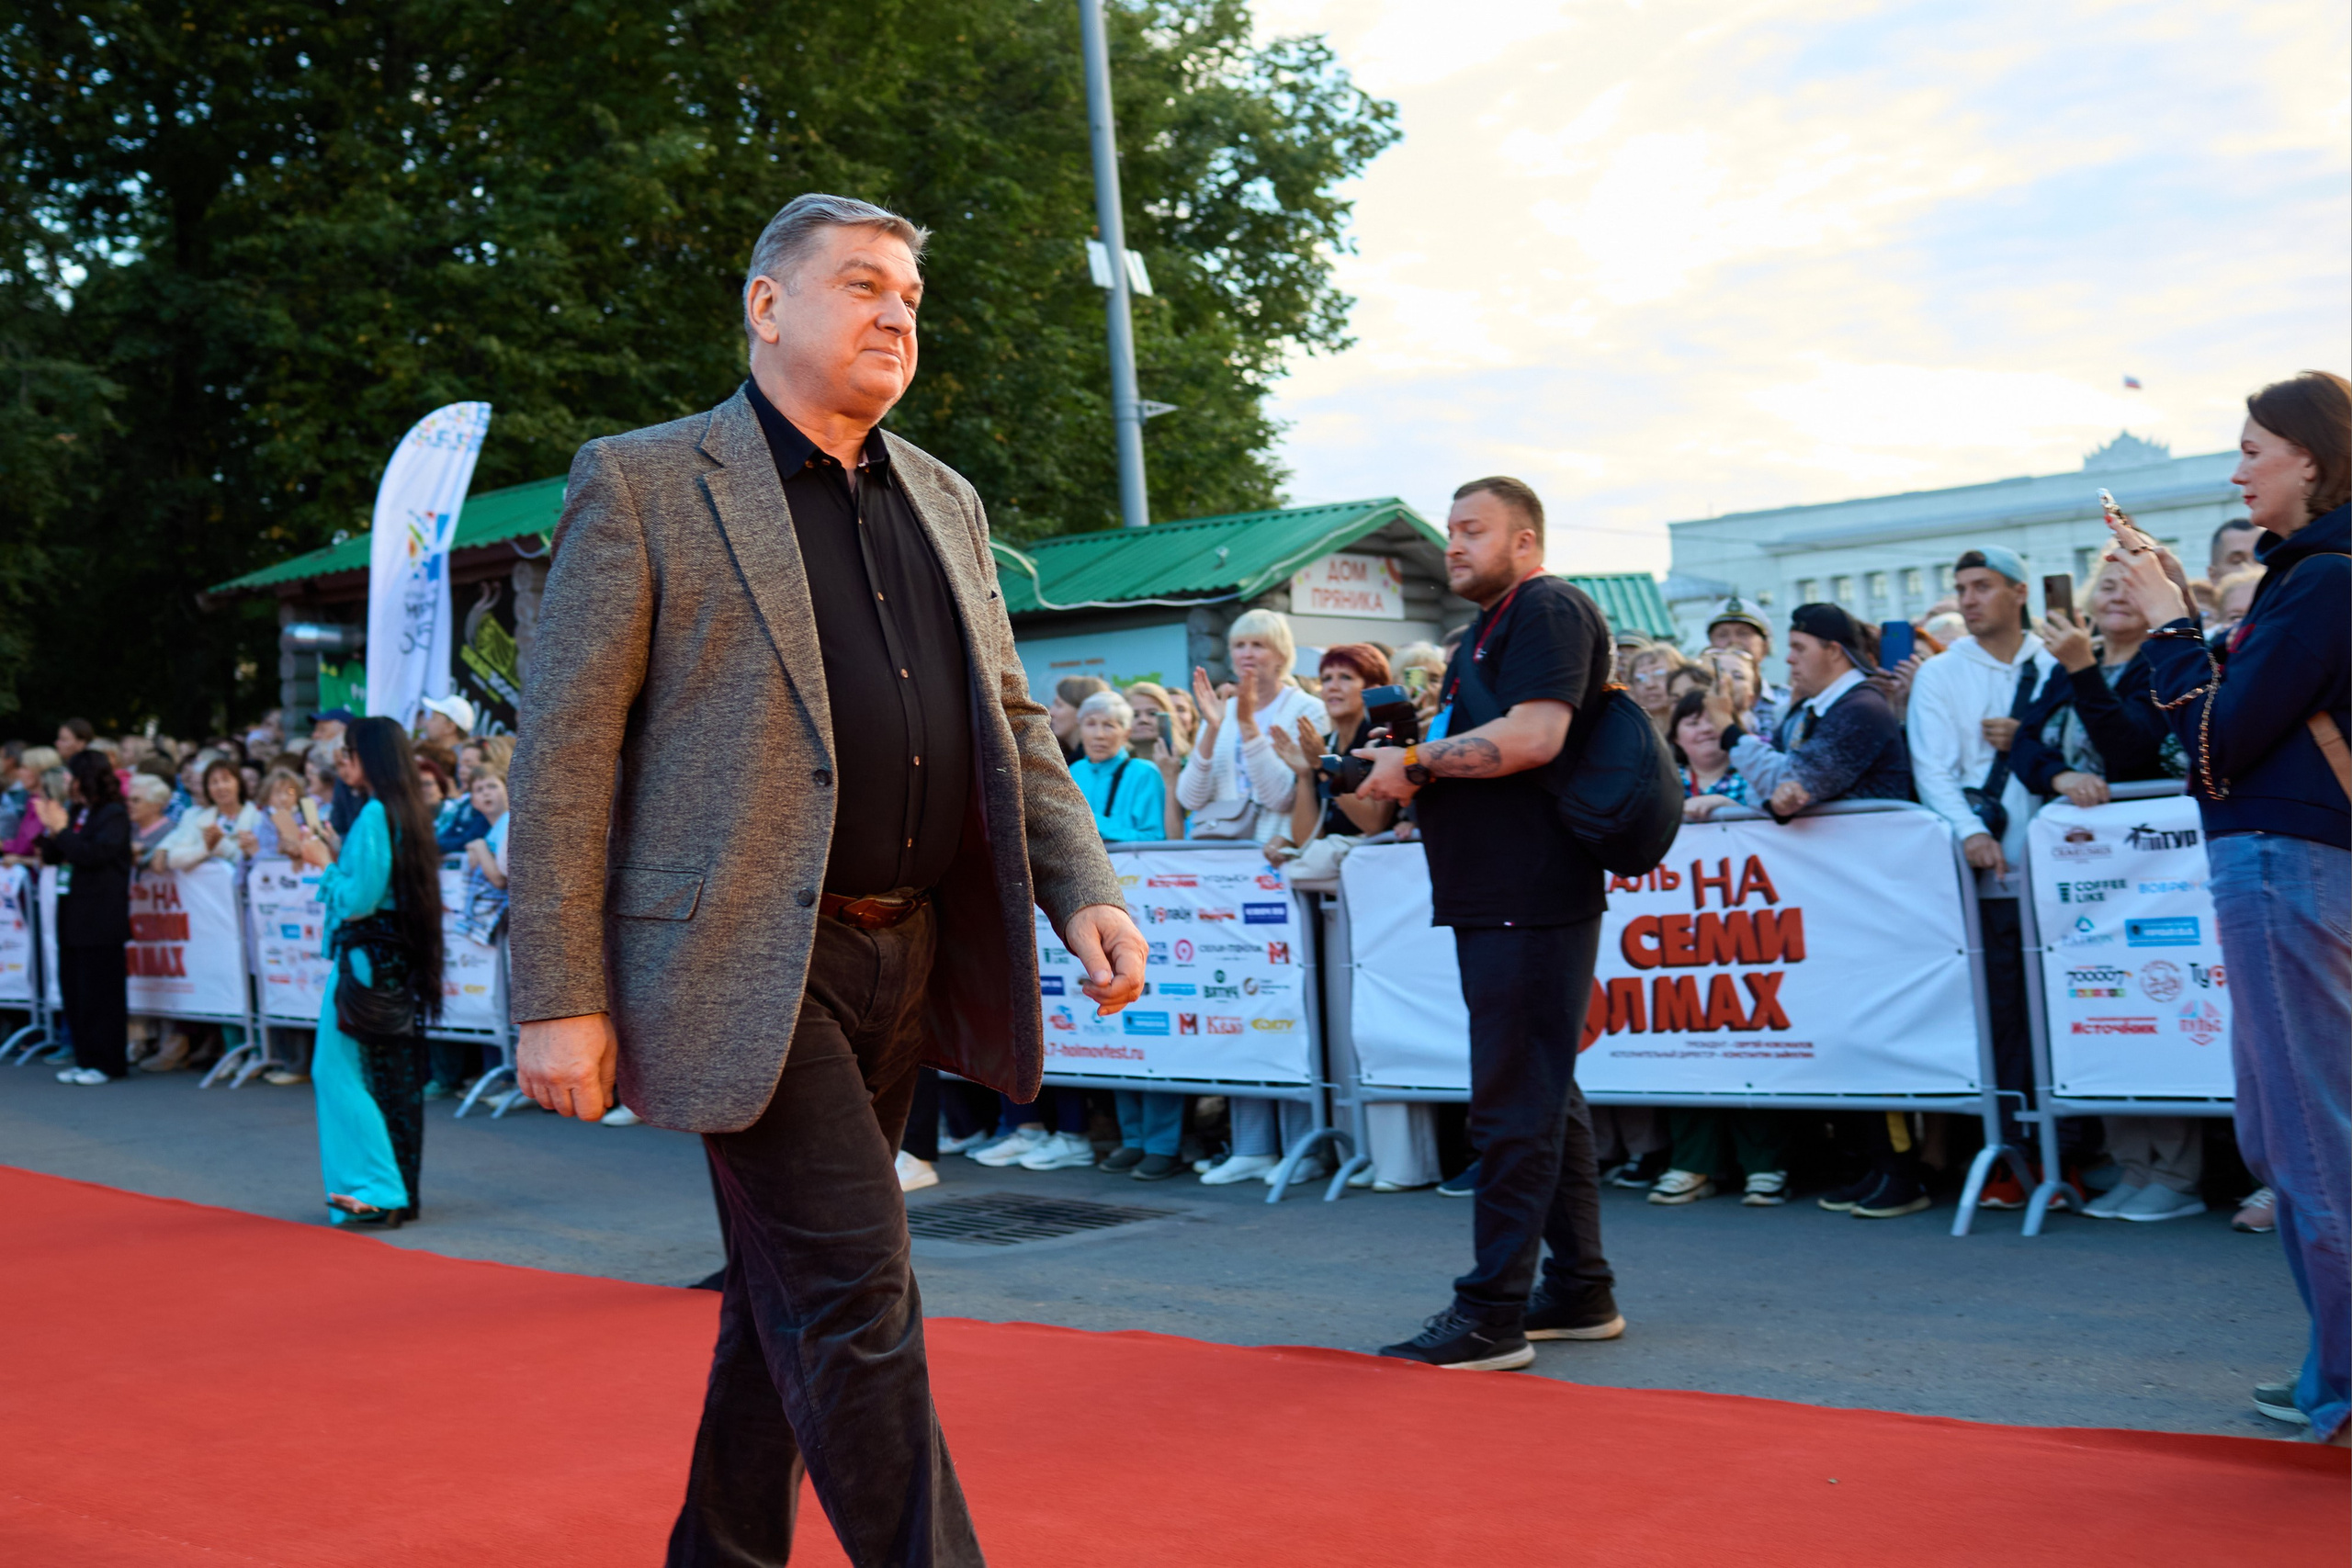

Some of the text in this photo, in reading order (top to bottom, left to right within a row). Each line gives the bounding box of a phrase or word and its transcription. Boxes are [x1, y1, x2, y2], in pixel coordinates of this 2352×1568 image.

[1328, 558, 1367, 582] ДОМ
[1311, 587, 1385, 612] ПРЯНИКА
[1691, 854, 1780, 909] НА
[2074, 878, 2127, 892] COFFEE
[2075, 892, 2106, 903] LIKE
[1621, 907, 1806, 969] СЕМИ
